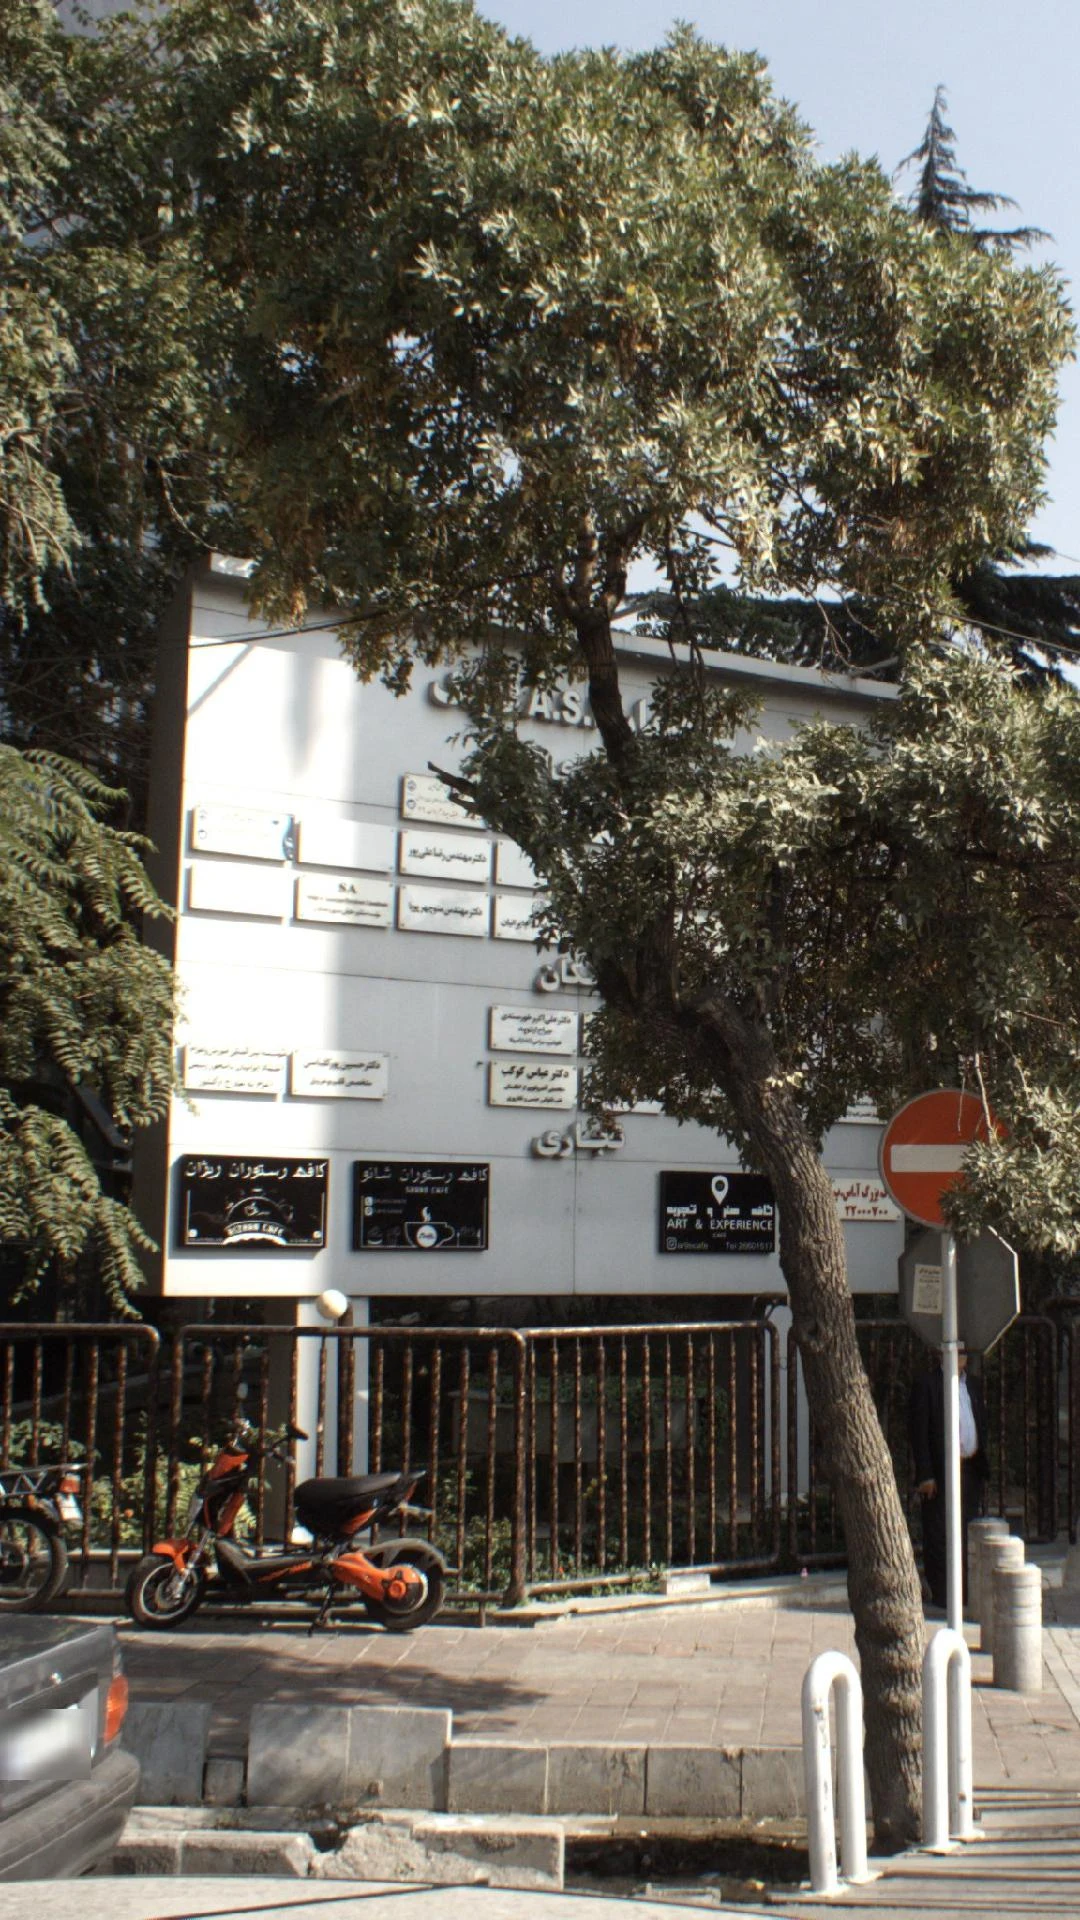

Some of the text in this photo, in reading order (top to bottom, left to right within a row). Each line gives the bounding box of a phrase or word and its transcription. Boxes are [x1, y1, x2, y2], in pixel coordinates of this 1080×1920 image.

[229, 1162, 288, 1180] رستوران
[292, 1161, 327, 1178] کافه
[400, 1168, 453, 1184] رستوران
[458, 1168, 488, 1182] کافه
[751, 1204, 773, 1216] کافه
[666, 1218, 773, 1231] ART & EXPERIENCE
